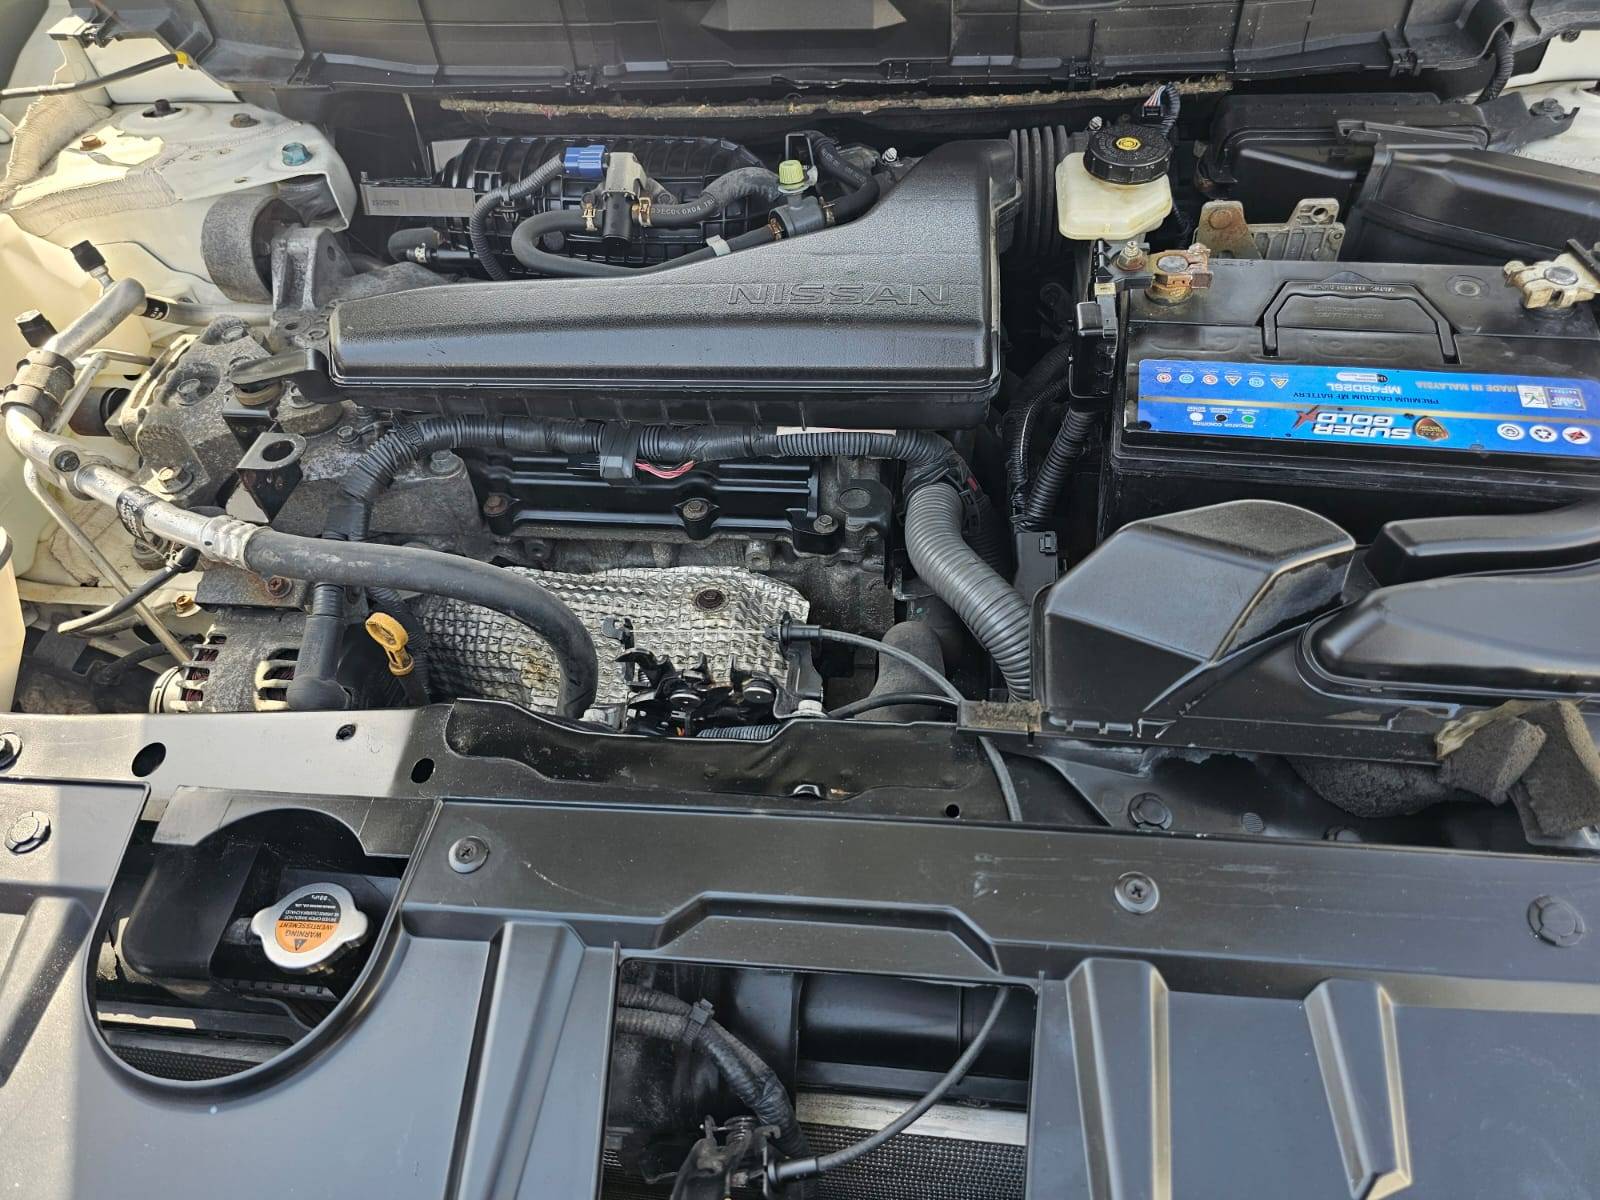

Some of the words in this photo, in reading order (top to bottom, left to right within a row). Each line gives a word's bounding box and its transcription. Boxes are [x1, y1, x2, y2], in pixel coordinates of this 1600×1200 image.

[728, 283, 949, 306] NISSAN
[1415, 381, 1469, 391] MALAYSIA
[1471, 383, 1483, 392] IN
[1485, 384, 1517, 393] MADE
[1292, 392, 1333, 400] BATTERY
[1351, 394, 1393, 403] CALCIUM
[1394, 397, 1440, 405] PREMIUM
[1315, 412, 1394, 427] GOLD
[1312, 423, 1411, 440] SUPER
[279, 921, 334, 931] AVERTISSEMENT
[285, 930, 322, 939] WARNING
